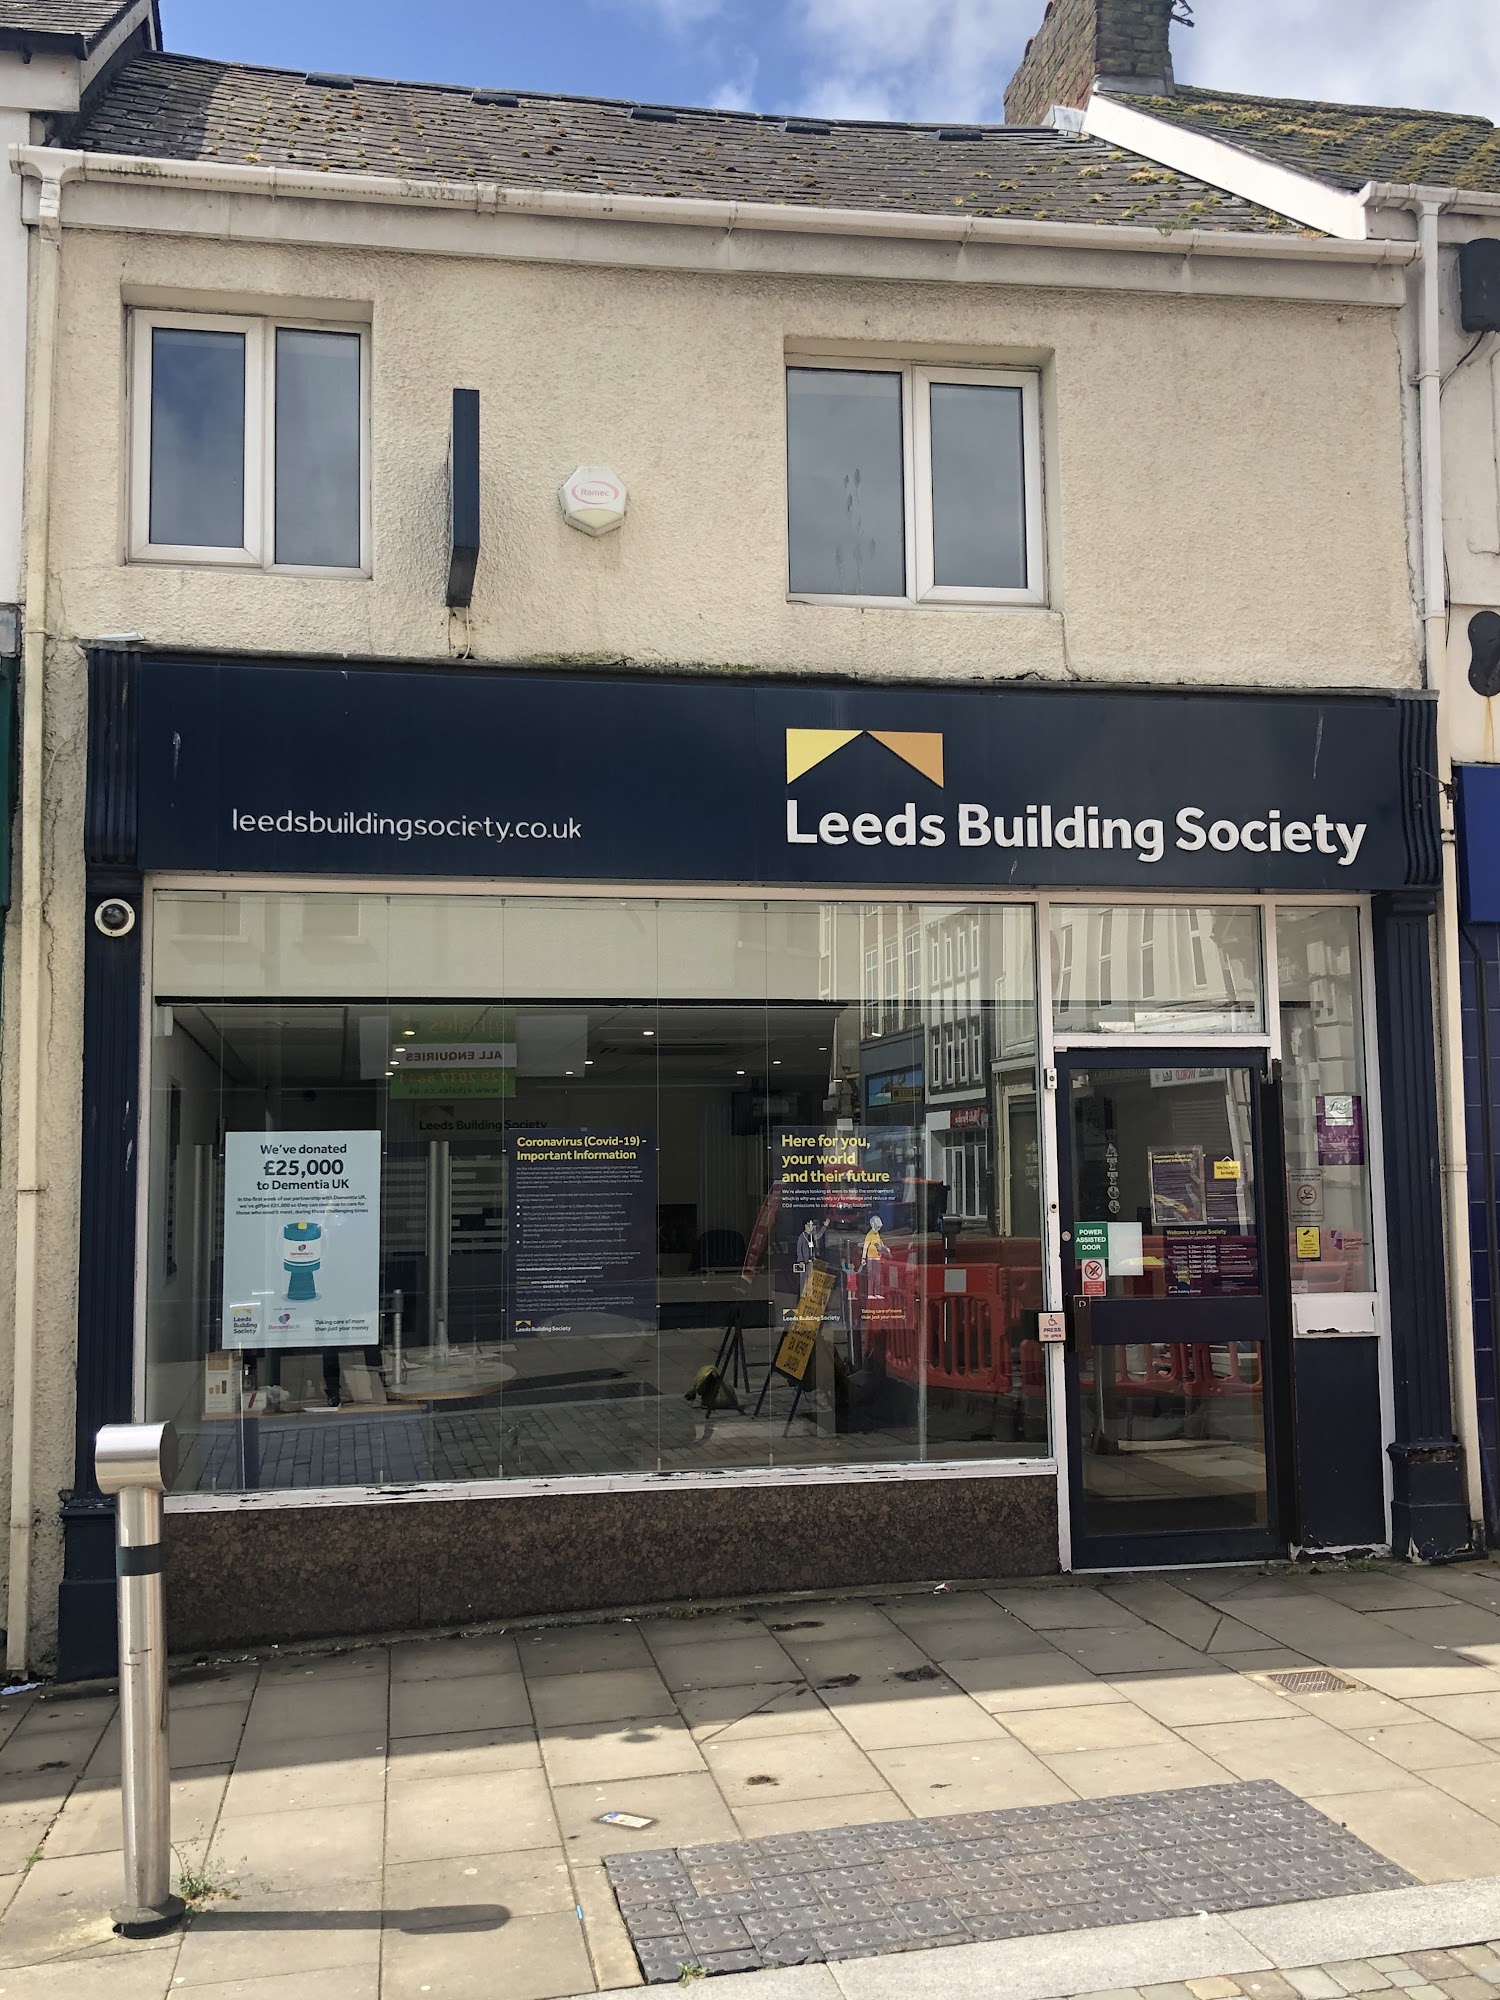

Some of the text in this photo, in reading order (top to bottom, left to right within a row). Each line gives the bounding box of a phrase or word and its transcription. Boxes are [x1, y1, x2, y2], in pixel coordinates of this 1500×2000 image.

[580, 487, 609, 497] Romec
[232, 808, 583, 843] leedsbuildingsociety.co.uk
[786, 799, 1367, 866] Leeds Building Society
[419, 1120, 547, 1132] Leeds Building Society
[517, 1136, 582, 1147] Coronavirus
[584, 1135, 640, 1148] (Covid-19)
[782, 1134, 871, 1150] Here for you,
[260, 1143, 347, 1155] We've donated
[517, 1151, 636, 1162] Important Information
[782, 1152, 856, 1168] your world
[263, 1159, 344, 1178] £25,000
[782, 1169, 890, 1183] and their future
[257, 1179, 350, 1190] to Dementia UK
[1208, 1228, 1227, 1236] Society
